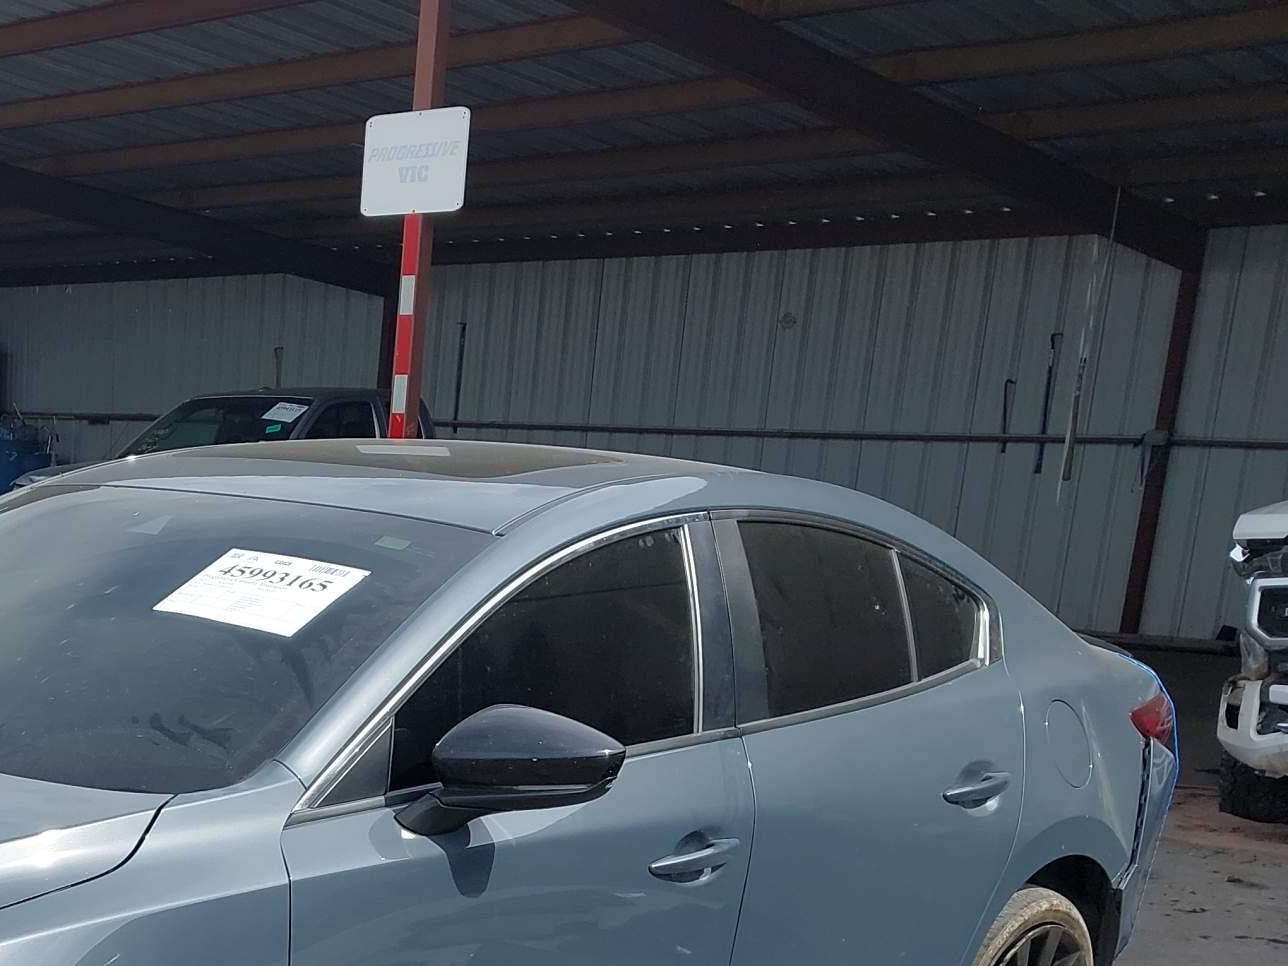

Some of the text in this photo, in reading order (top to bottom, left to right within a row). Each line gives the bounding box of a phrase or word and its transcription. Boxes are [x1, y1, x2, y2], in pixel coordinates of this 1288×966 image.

[367, 140, 462, 162] PROGRESSIVE
[398, 165, 429, 184] VIC
[219, 564, 334, 592] 45993165
